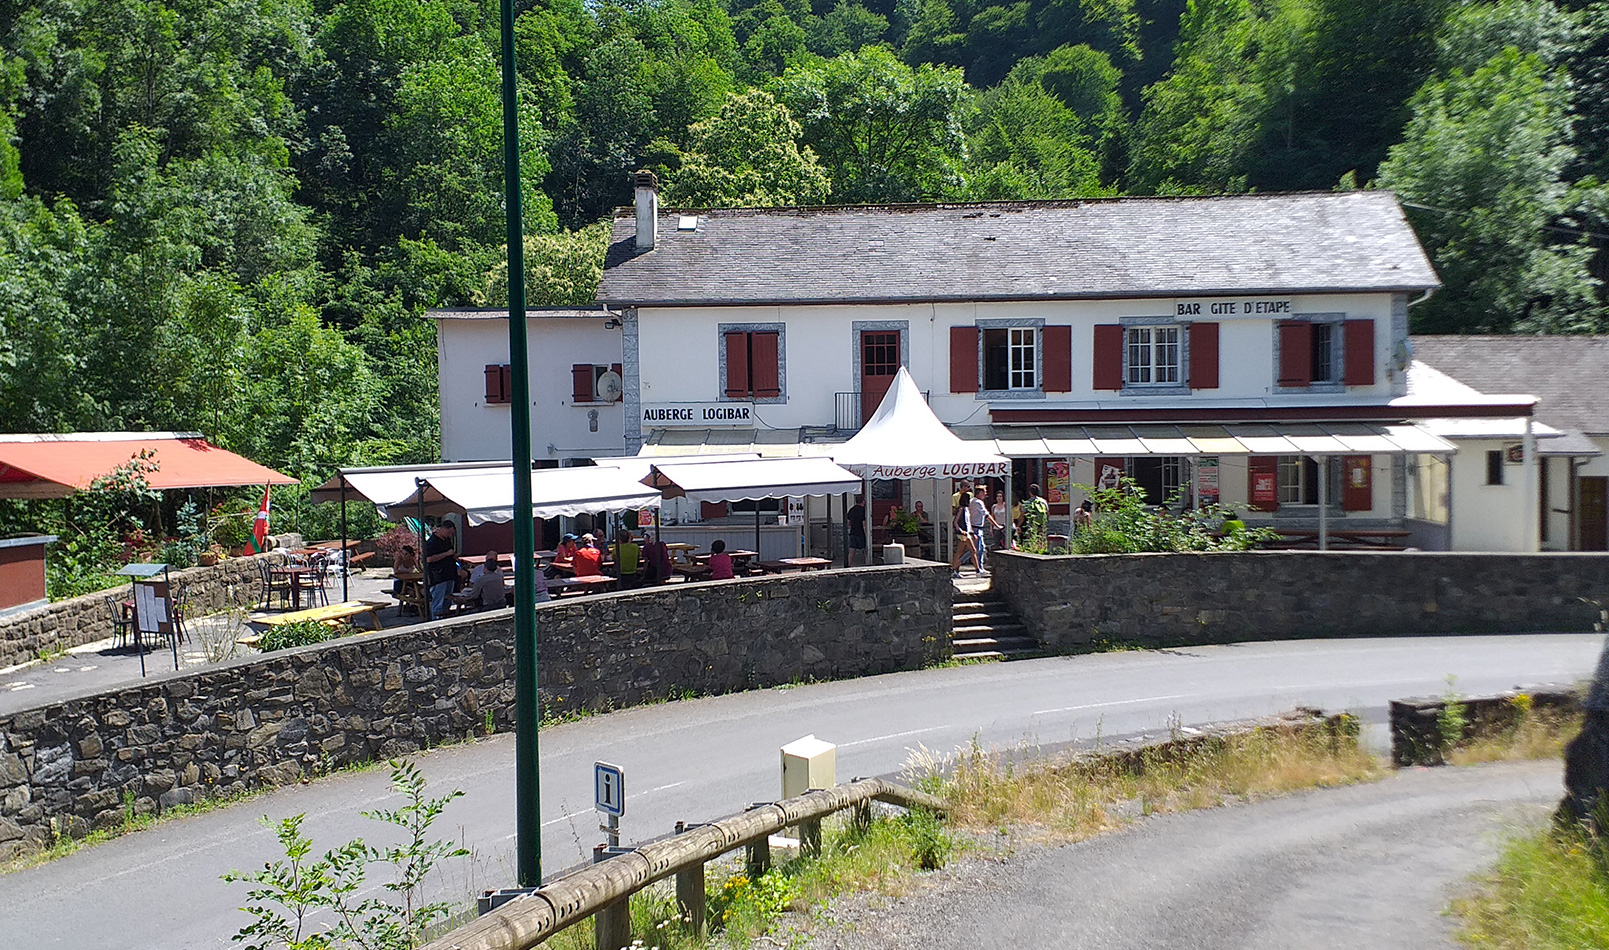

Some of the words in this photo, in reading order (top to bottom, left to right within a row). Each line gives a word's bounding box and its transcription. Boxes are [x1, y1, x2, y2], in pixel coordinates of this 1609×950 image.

[1177, 303, 1201, 315] BAR
[1211, 302, 1236, 315] GITE
[1244, 301, 1290, 314] D'ETAPE
[643, 408, 694, 421] AUBERGE
[702, 407, 750, 420] LOGIBAR
[872, 465, 936, 479] Auberge
[942, 463, 1008, 475] LOGIBAR
